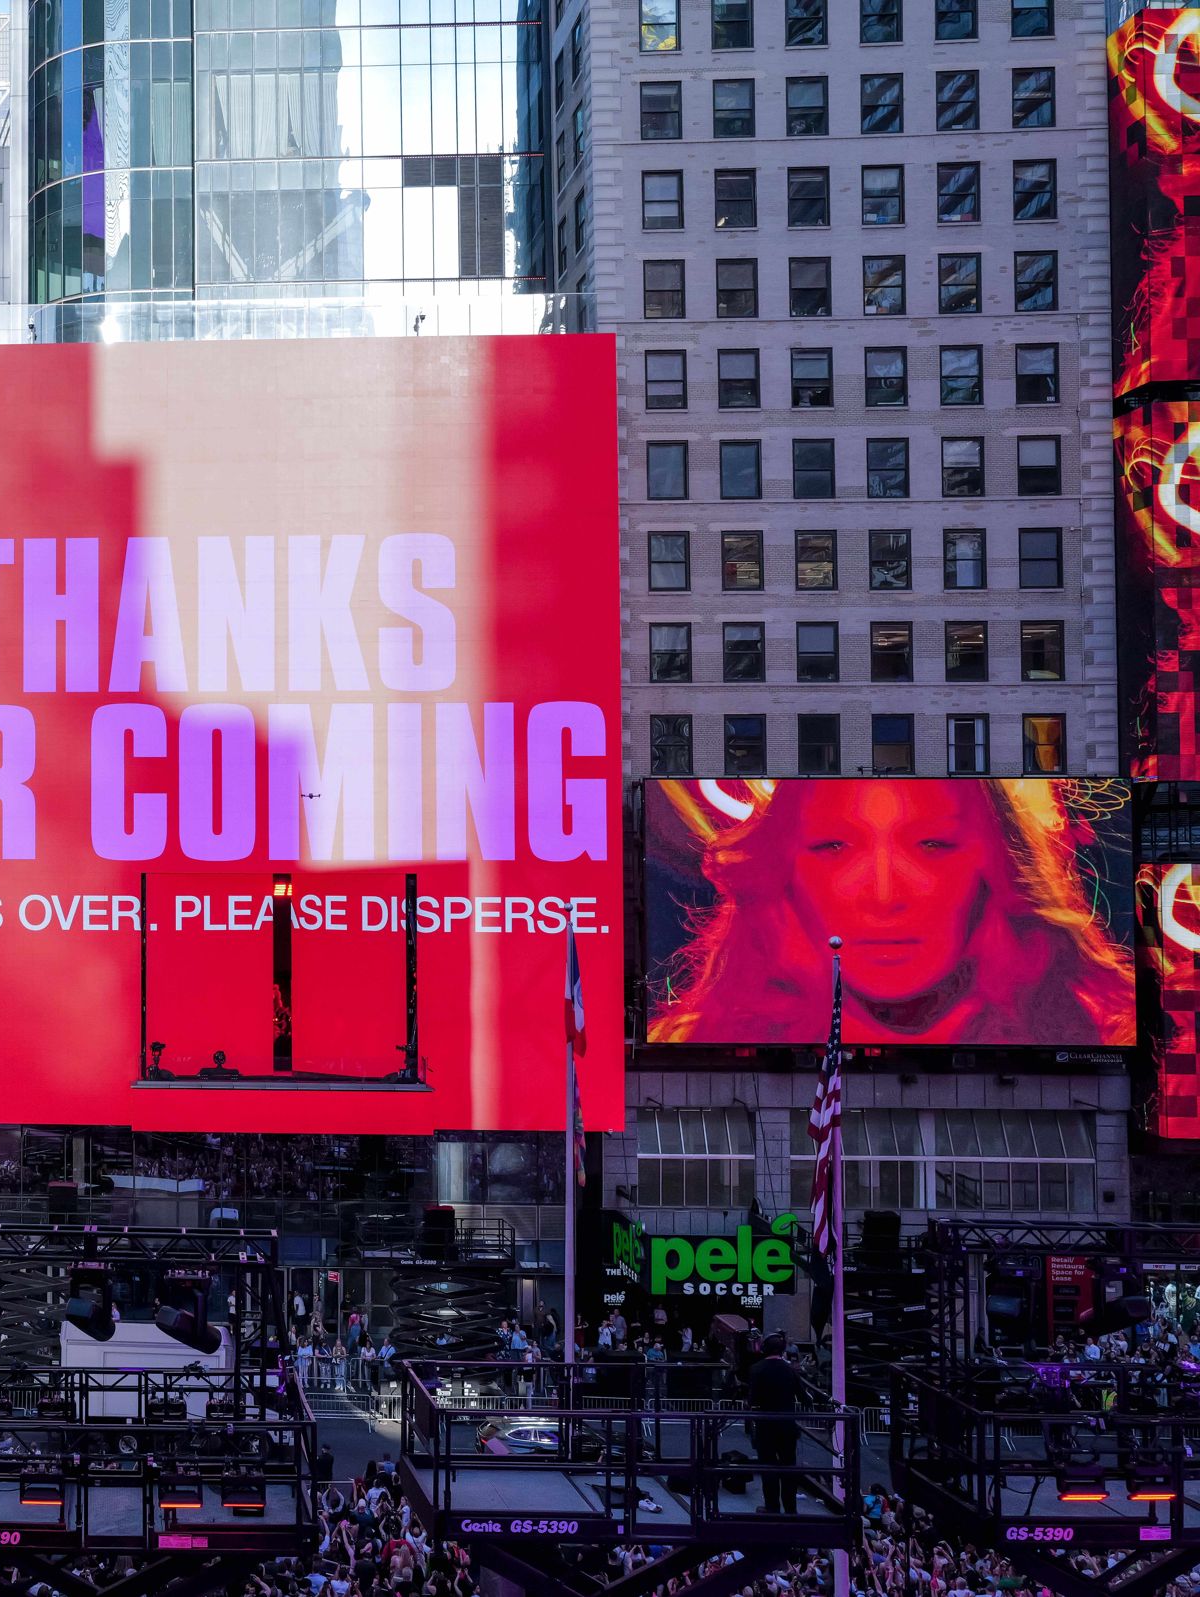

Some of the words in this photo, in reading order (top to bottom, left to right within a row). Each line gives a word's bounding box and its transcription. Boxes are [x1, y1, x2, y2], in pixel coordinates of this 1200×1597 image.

[90, 701, 609, 862] COMING
[17, 893, 158, 932] OVER.
[175, 894, 347, 931] PLEASE
[362, 895, 609, 934] DISPERSE.
[651, 1213, 798, 1296] pelé
[1051, 1255, 1075, 1264] Retail/
[605, 1268, 622, 1276] THE
[683, 1282, 775, 1296] SOCCER
[461, 1519, 502, 1533] Genie
[510, 1520, 578, 1534] GS-5390
[1006, 1527, 1074, 1541] GS-5390
